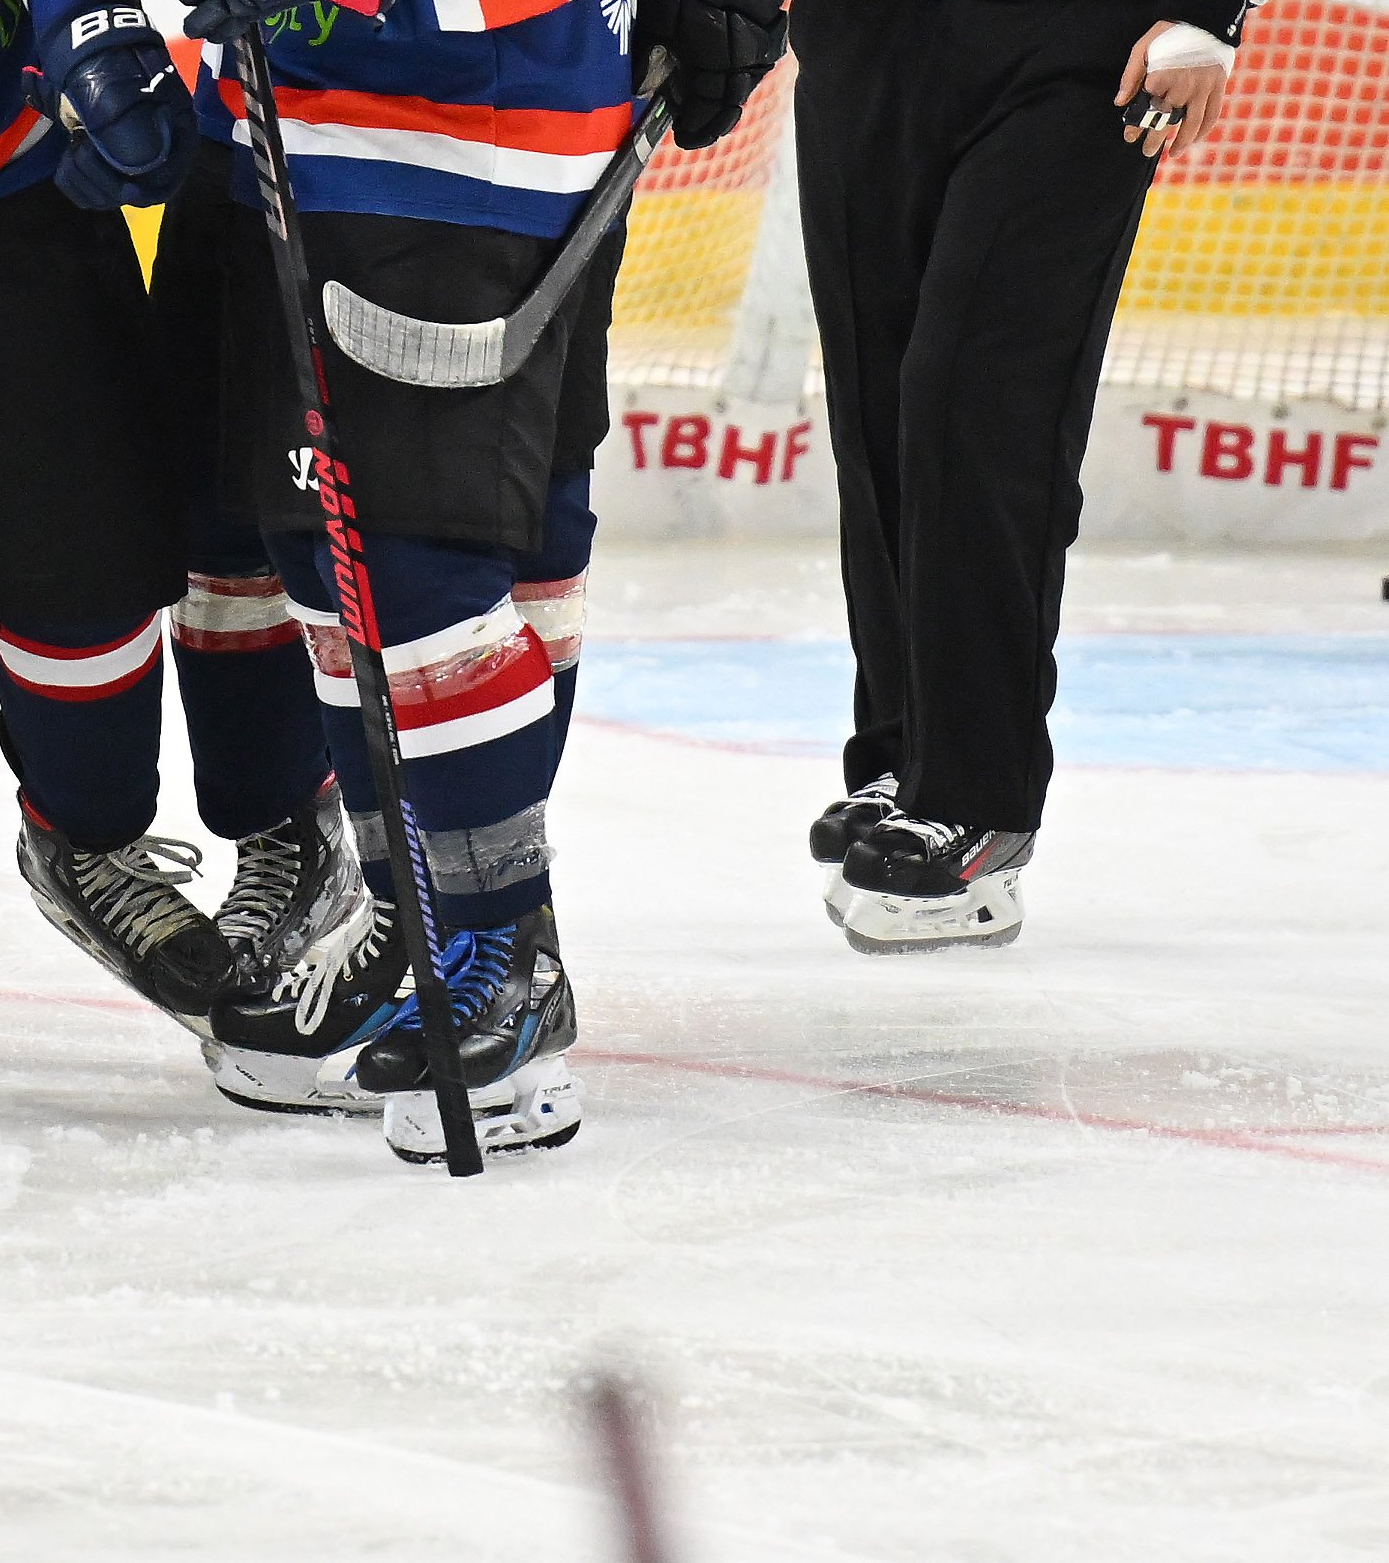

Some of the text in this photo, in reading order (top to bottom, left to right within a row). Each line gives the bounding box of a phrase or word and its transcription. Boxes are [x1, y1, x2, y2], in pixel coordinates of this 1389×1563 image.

[621, 412, 813, 485] TBHF
[1141, 413, 1380, 491] TBHF
[312, 446, 367, 647] NOVIUM
